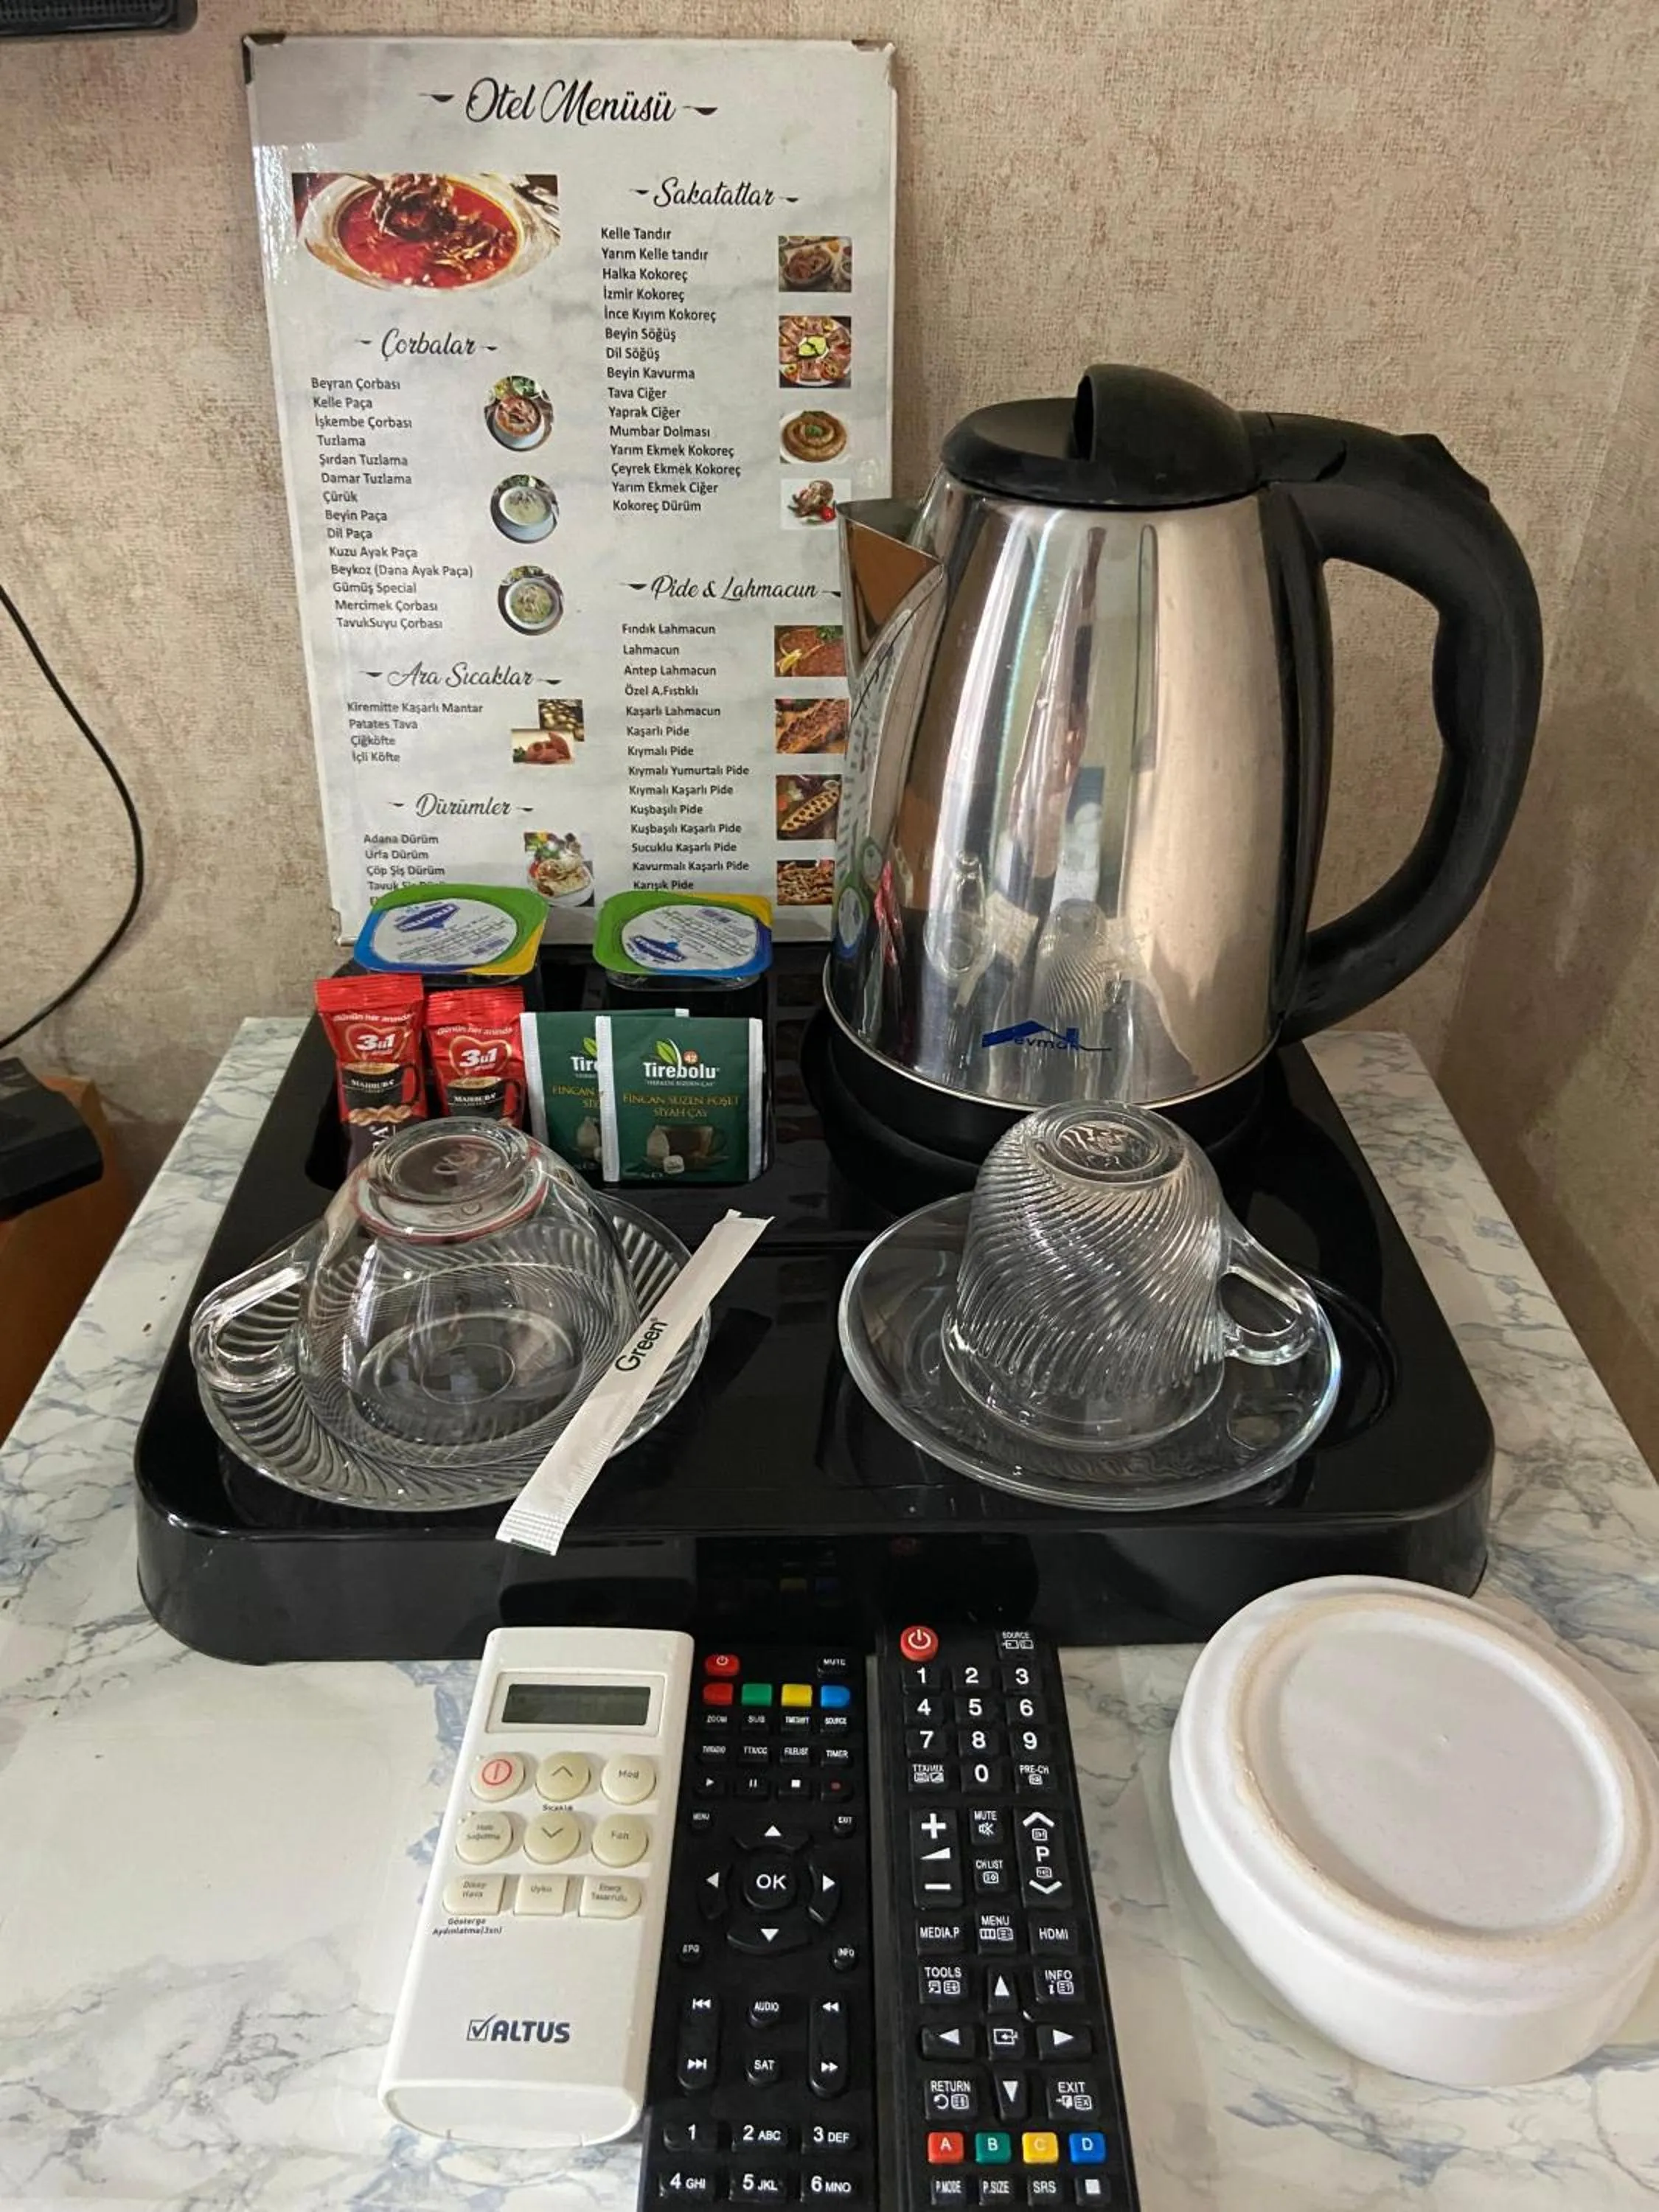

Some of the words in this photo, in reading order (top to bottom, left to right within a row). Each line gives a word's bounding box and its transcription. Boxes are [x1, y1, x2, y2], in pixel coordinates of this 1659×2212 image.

[466, 77, 535, 123] Otel
[540, 79, 676, 126] Menüsü
[654, 177, 774, 207] Sakatatlar
[600, 227, 630, 240] Kelle
[633, 228, 672, 240] Tandır
[601, 247, 636, 260] Yarım
[639, 248, 669, 260] Kelle
[671, 248, 709, 261] tandır
[602, 268, 636, 280] Halka
[639, 268, 688, 282] Kokoreç
[603, 286, 633, 301] İzmir
[636, 288, 685, 303] Kokoreç
[604, 307, 629, 320] İnce
[632, 308, 665, 323] Kıyım
[669, 309, 717, 323] Kokoreç
[605, 328, 638, 341] Beyin
[641, 327, 677, 343] Söğüş
[382, 327, 476, 361] Çorbalar
[605, 347, 622, 359] Dil
[625, 347, 661, 362] Söğüş
[606, 367, 640, 381] Beyin
[642, 368, 695, 380] Kavurma
[608, 387, 634, 399] Tava
[636, 387, 667, 402] Ciğer
[313, 397, 341, 408] Kelle
[345, 397, 373, 411] Paça
[608, 406, 648, 421] Yaprak
[650, 406, 681, 421] Ciğer
[609, 425, 660, 437] Mumbar
[663, 425, 710, 438] Dolması
[316, 434, 366, 447] Tuzlama
[610, 445, 644, 456] Yarım
[647, 445, 686, 456] Ekmek
[687, 445, 734, 459] Kokoreç
[319, 453, 356, 467] Şırdan
[358, 454, 408, 466] Tuzlama
[611, 463, 651, 476] Çeyrek
[653, 463, 692, 475] Ekmek
[695, 463, 741, 477] Kokoreç
[321, 472, 361, 484] Damar
[363, 473, 412, 485] Tuzlama
[612, 481, 645, 493] Yarım
[647, 481, 686, 494] Ekmek
[689, 482, 718, 496] Ciğer
[613, 500, 658, 514] Kokoreç
[661, 500, 701, 512] Dürüm
[324, 509, 358, 523] Beyin
[360, 509, 388, 524] Paça
[327, 528, 343, 540] Dil
[345, 529, 373, 541] Paça
[329, 546, 358, 557] Kuzu
[360, 546, 388, 559] Ayak
[391, 547, 418, 560] Paça
[330, 564, 371, 577] Beykoz
[411, 566, 439, 577] Ayak
[442, 566, 473, 579] Paça)
[652, 574, 698, 599] Pide
[703, 580, 716, 598] &
[721, 576, 818, 600] Lahmacun
[334, 599, 393, 611] Mercimek
[395, 599, 438, 613] Çorbası
[622, 623, 655, 636] Fındık
[658, 624, 716, 636] Lahmacun
[623, 644, 680, 656] Lahmacun
[387, 661, 440, 686] Ara
[446, 661, 533, 687] Sıcaklar
[623, 665, 658, 678] Antep
[660, 665, 717, 677] Lahmacun
[625, 706, 662, 719] Kaşarlı
[664, 706, 721, 717] Lahmacun
[348, 719, 390, 730] Patates
[392, 719, 418, 730] Tava
[627, 726, 663, 738] Kaşarlı
[666, 726, 690, 737] Pide
[627, 745, 667, 758] Kıymalı
[670, 745, 695, 757] Pide
[628, 765, 668, 778] Kıymalı
[670, 765, 723, 776] Yumurtalı
[726, 765, 750, 776] Pide
[629, 785, 669, 797] Kıymalı
[671, 785, 707, 798] Kaşarlı
[709, 785, 734, 796] Pide
[416, 793, 512, 817] Dürümler
[679, 804, 703, 815] Pide
[680, 824, 716, 835] Kaşarlı
[718, 824, 742, 834] Pide
[364, 833, 399, 845] Adana
[400, 834, 439, 845] Dürüm
[631, 842, 673, 854] Sucuklu
[675, 842, 711, 855] Kaşarlı
[713, 842, 737, 853] Pide
[632, 861, 686, 872] Kavurmalı
[687, 861, 723, 873] Kaşarlı
[726, 860, 750, 872] Pide
[643, 1062, 716, 1079] Tirebolu
[615, 1320, 668, 1372] Green
[917, 1668, 926, 1683] 1
[965, 1667, 978, 1683] 2
[1015, 1669, 1029, 1685] 3
[917, 1699, 931, 1716] 4
[969, 1699, 982, 1716] 5
[1020, 1699, 1034, 1717] 6
[920, 1731, 933, 1748] 7
[972, 1731, 986, 1748] 8
[1023, 1733, 1037, 1750] 9
[975, 1811, 997, 1820] MUTE
[1036, 1846, 1049, 1862] P
[757, 1874, 787, 1889] OK
[920, 1927, 959, 1939] MEDIA.P
[981, 1916, 1009, 1926] MENU
[1039, 1928, 1068, 1940] HDMI
[925, 1967, 961, 1978] TOOLS
[1045, 1970, 1072, 1980] INFO
[754, 2003, 779, 2011] AUDIO
[491, 2020, 570, 2043] ALTUS
[754, 2060, 775, 2070] SAT
[931, 2081, 970, 2093] RETURN
[1058, 2082, 1085, 2093] EXIT
[689, 2124, 695, 2140] 1
[743, 2125, 754, 2140] 2
[758, 2130, 781, 2140] ABC
[813, 2127, 824, 2142] 3
[828, 2132, 849, 2143] DEF
[940, 2138, 952, 2150] A
[988, 2138, 998, 2150] B
[1034, 2139, 1046, 2150] C
[1082, 2138, 1093, 2151] D
[670, 2173, 681, 2189] 4
[686, 2178, 706, 2189] GHI
[743, 2174, 754, 2190] 5
[758, 2179, 778, 2191] JKL
[811, 2176, 821, 2192] 6
[825, 2182, 851, 2192] MNO
